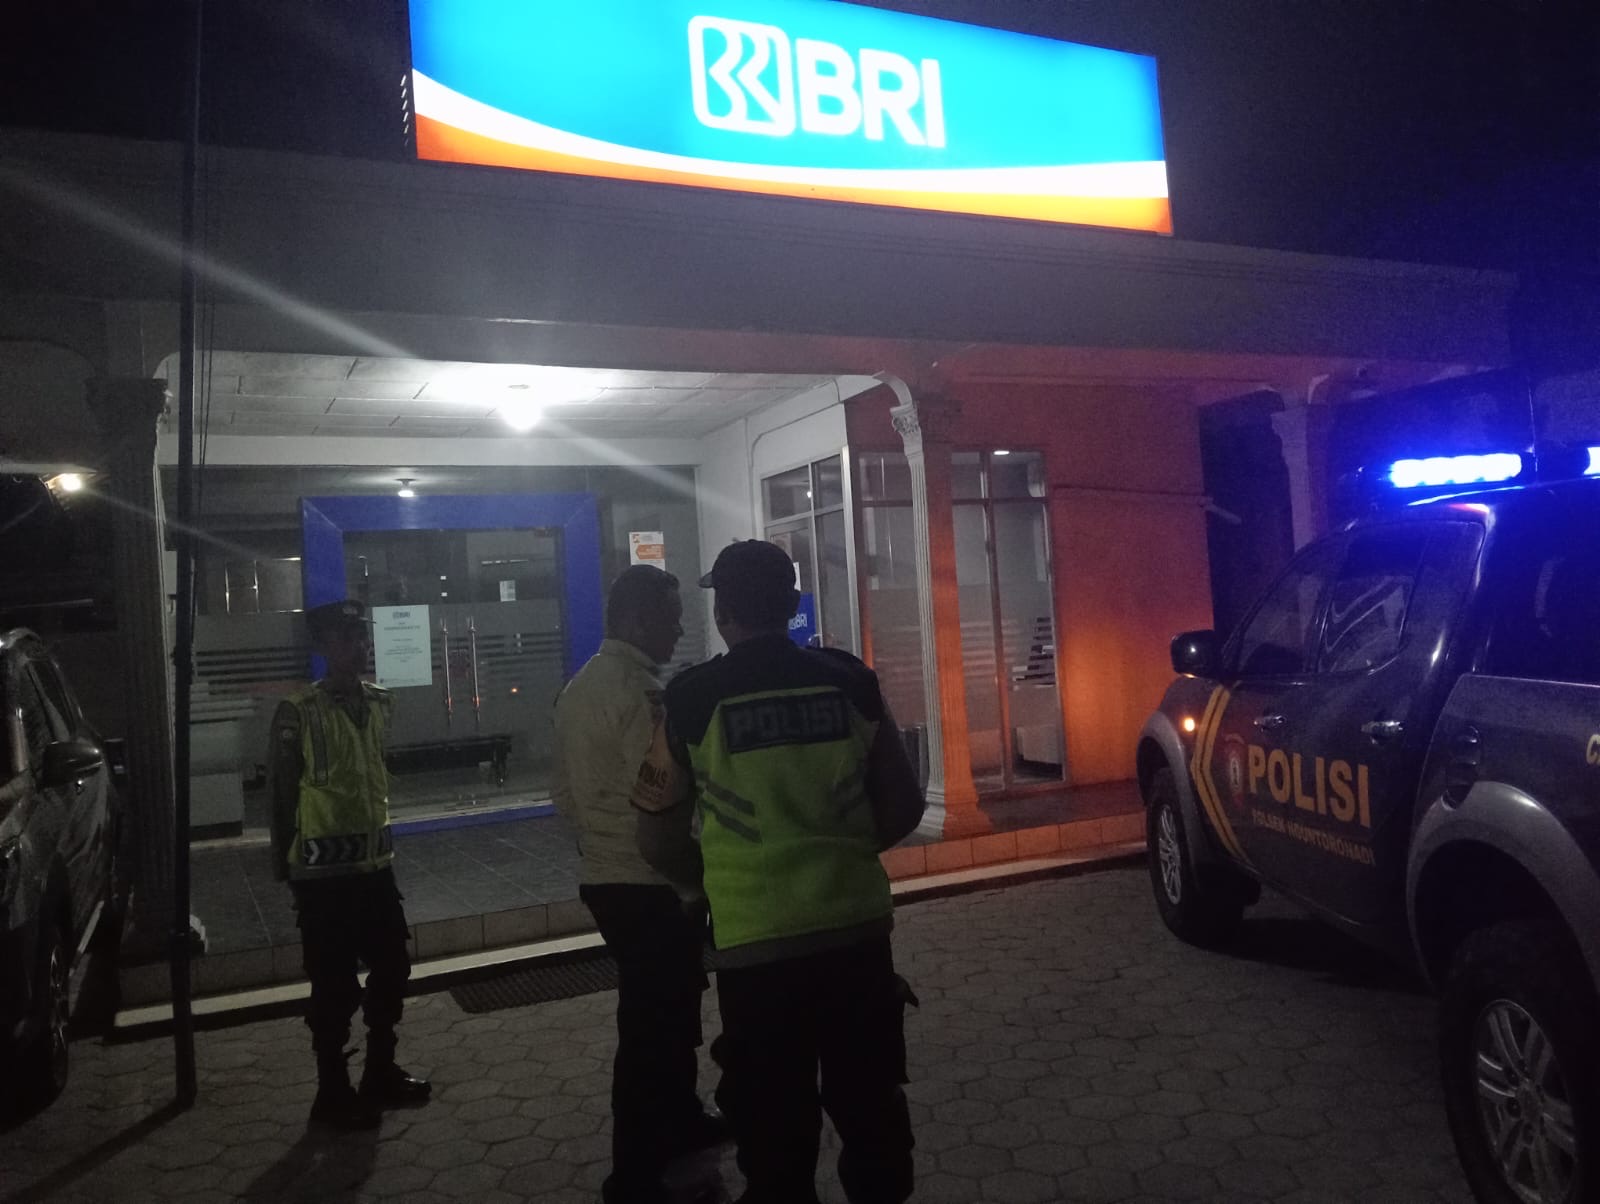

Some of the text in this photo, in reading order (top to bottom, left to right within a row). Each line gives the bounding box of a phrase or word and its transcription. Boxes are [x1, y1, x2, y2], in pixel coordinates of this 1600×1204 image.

[795, 37, 946, 149] BRI
[728, 699, 845, 743] POLISI
[1248, 744, 1371, 828] POLISI
[1252, 808, 1286, 833] POLSEK
